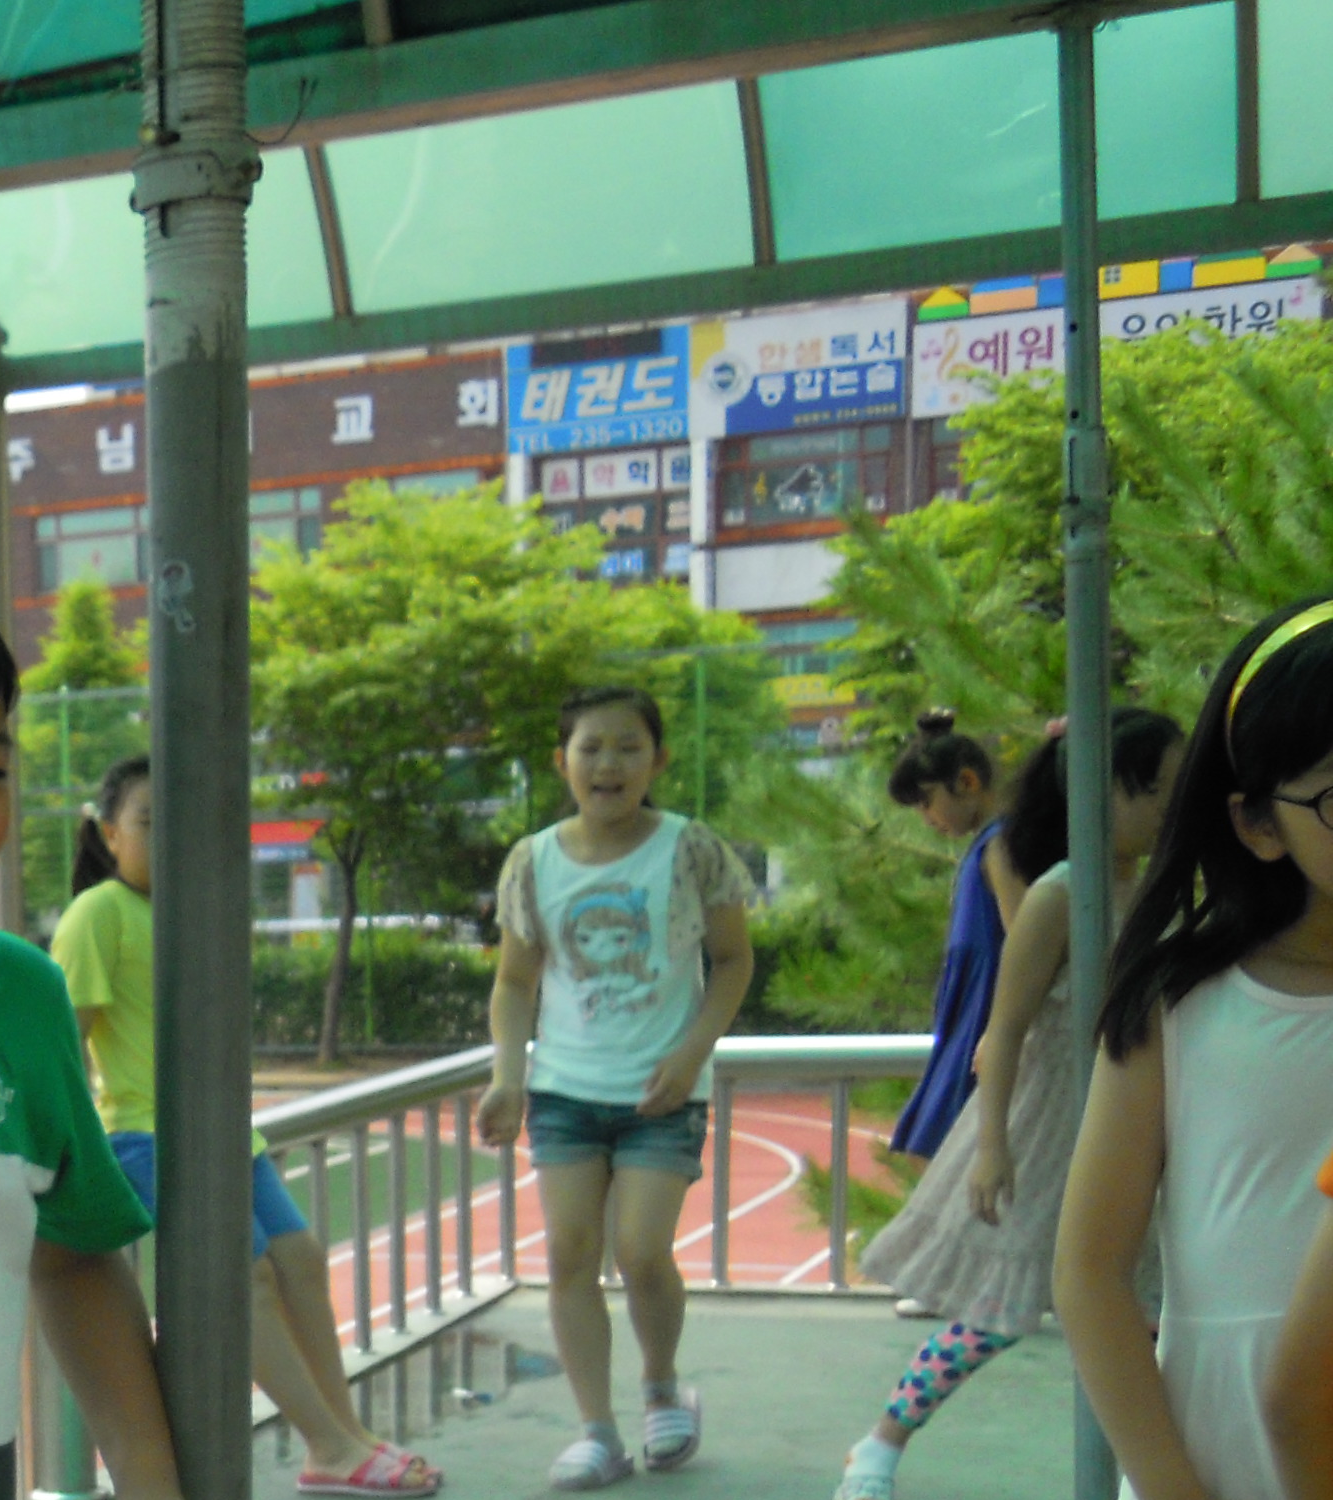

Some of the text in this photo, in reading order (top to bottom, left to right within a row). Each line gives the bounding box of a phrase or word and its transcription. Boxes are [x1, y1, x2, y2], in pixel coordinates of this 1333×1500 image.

[521, 356, 679, 421] 태권도
[757, 362, 897, 407] 통합논술
[516, 433, 554, 453] TEL
